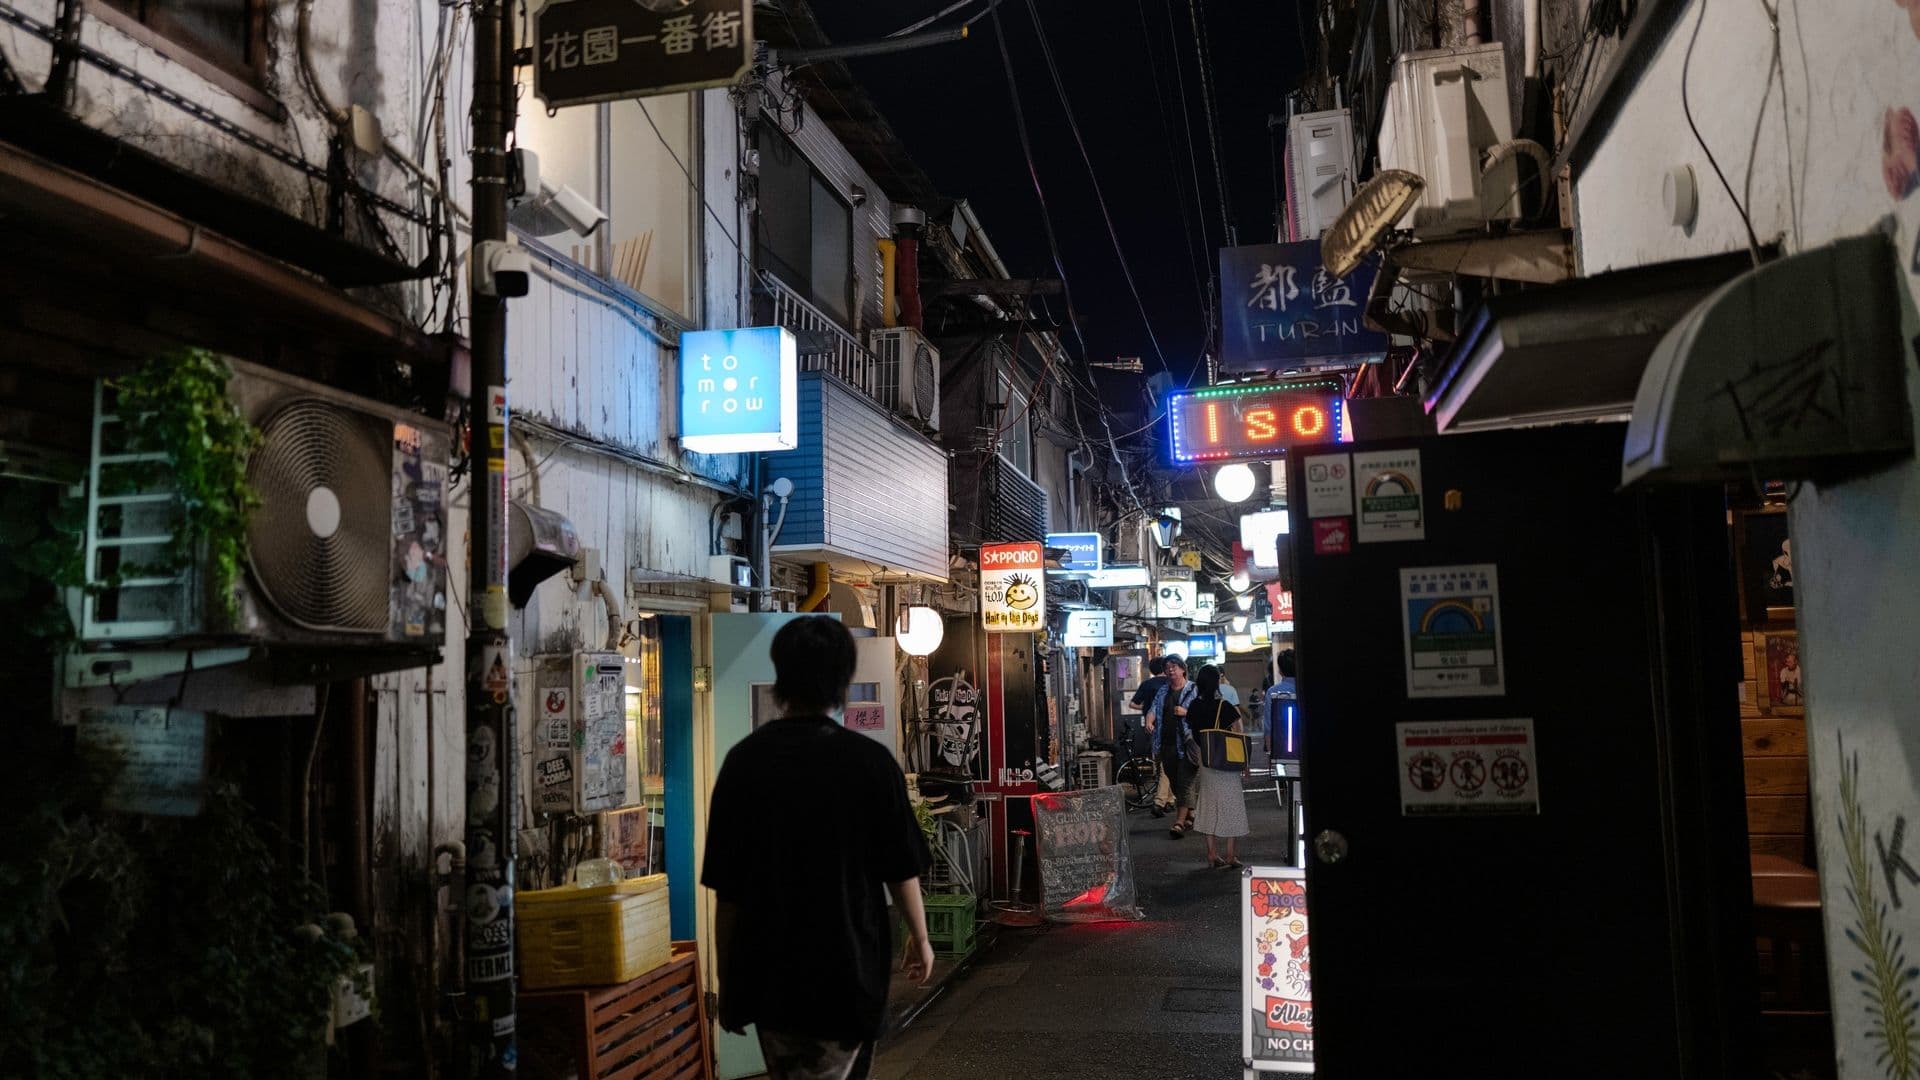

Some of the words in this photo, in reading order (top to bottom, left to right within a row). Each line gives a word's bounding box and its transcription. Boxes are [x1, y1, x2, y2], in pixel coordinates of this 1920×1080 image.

[544, 10, 742, 71] 花園一番街
[1250, 319, 1359, 342] TURAN
[1268, 1038, 1290, 1050] NO
